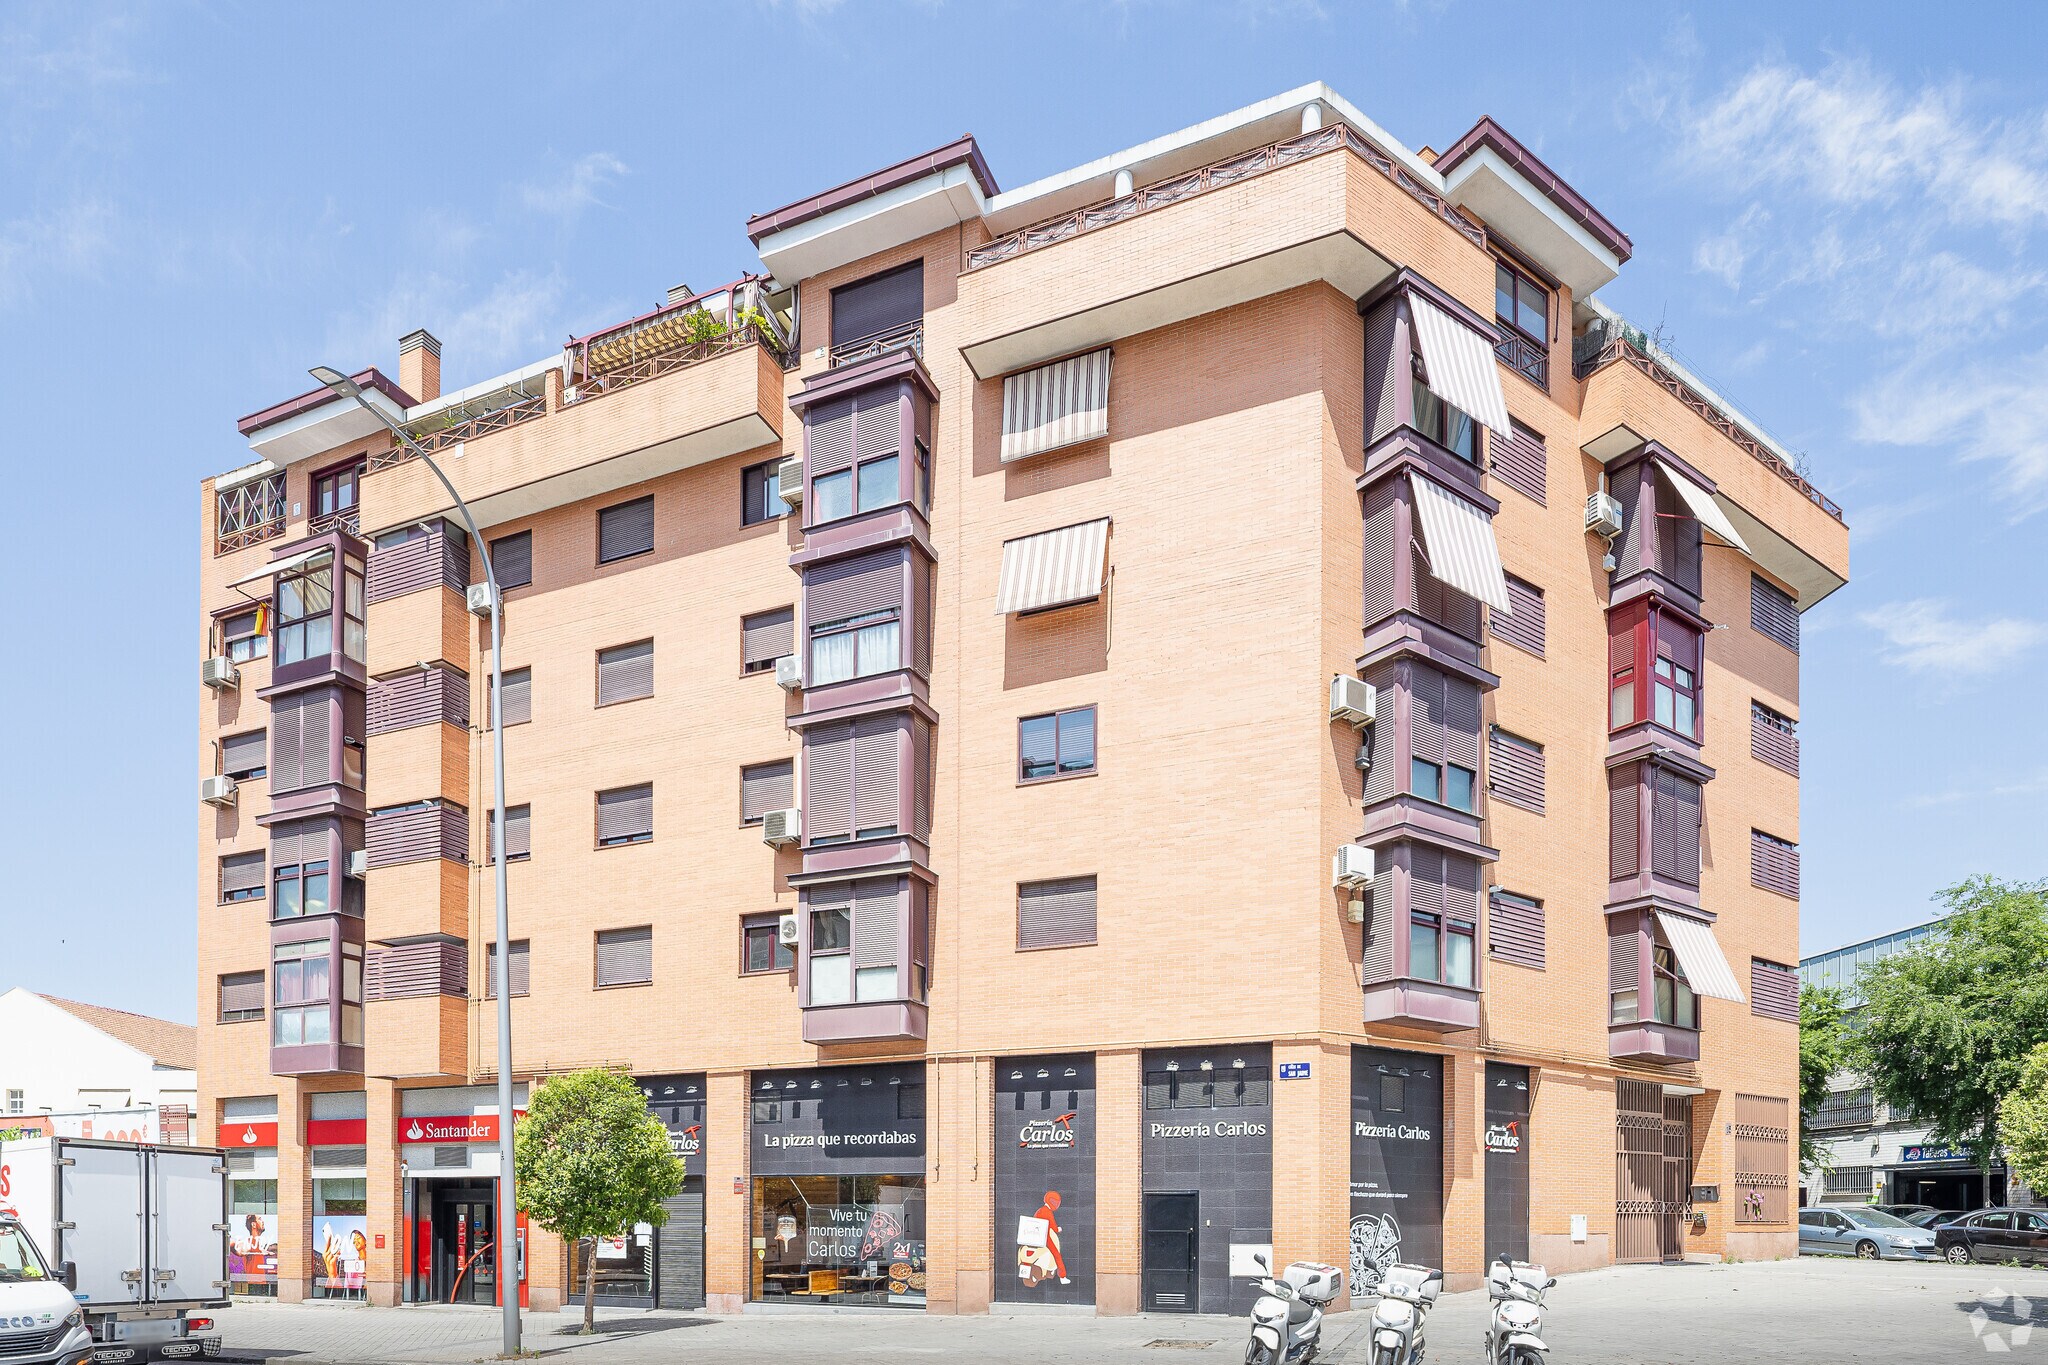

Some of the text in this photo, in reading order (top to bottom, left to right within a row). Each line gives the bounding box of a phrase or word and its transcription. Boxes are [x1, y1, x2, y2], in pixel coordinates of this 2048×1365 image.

[426, 1121, 490, 1138] Santander
[1020, 1125, 1073, 1142] Carlos
[1151, 1121, 1266, 1138] Pizzería Carlos
[1355, 1121, 1431, 1140] Pizzería Carlos
[667, 1135, 700, 1150] arlos
[764, 1131, 917, 1149] La pizza que recordabas
[1486, 1131, 1519, 1147] Carlos
[829, 1208, 867, 1221] Vive tu
[809, 1226, 863, 1237] momento
[809, 1240, 857, 1257] Carlos
[892, 1242, 910, 1252] 2x1
[97, 1351, 131, 1359] TECNOVE
[165, 1345, 197, 1353] TECNOVE
